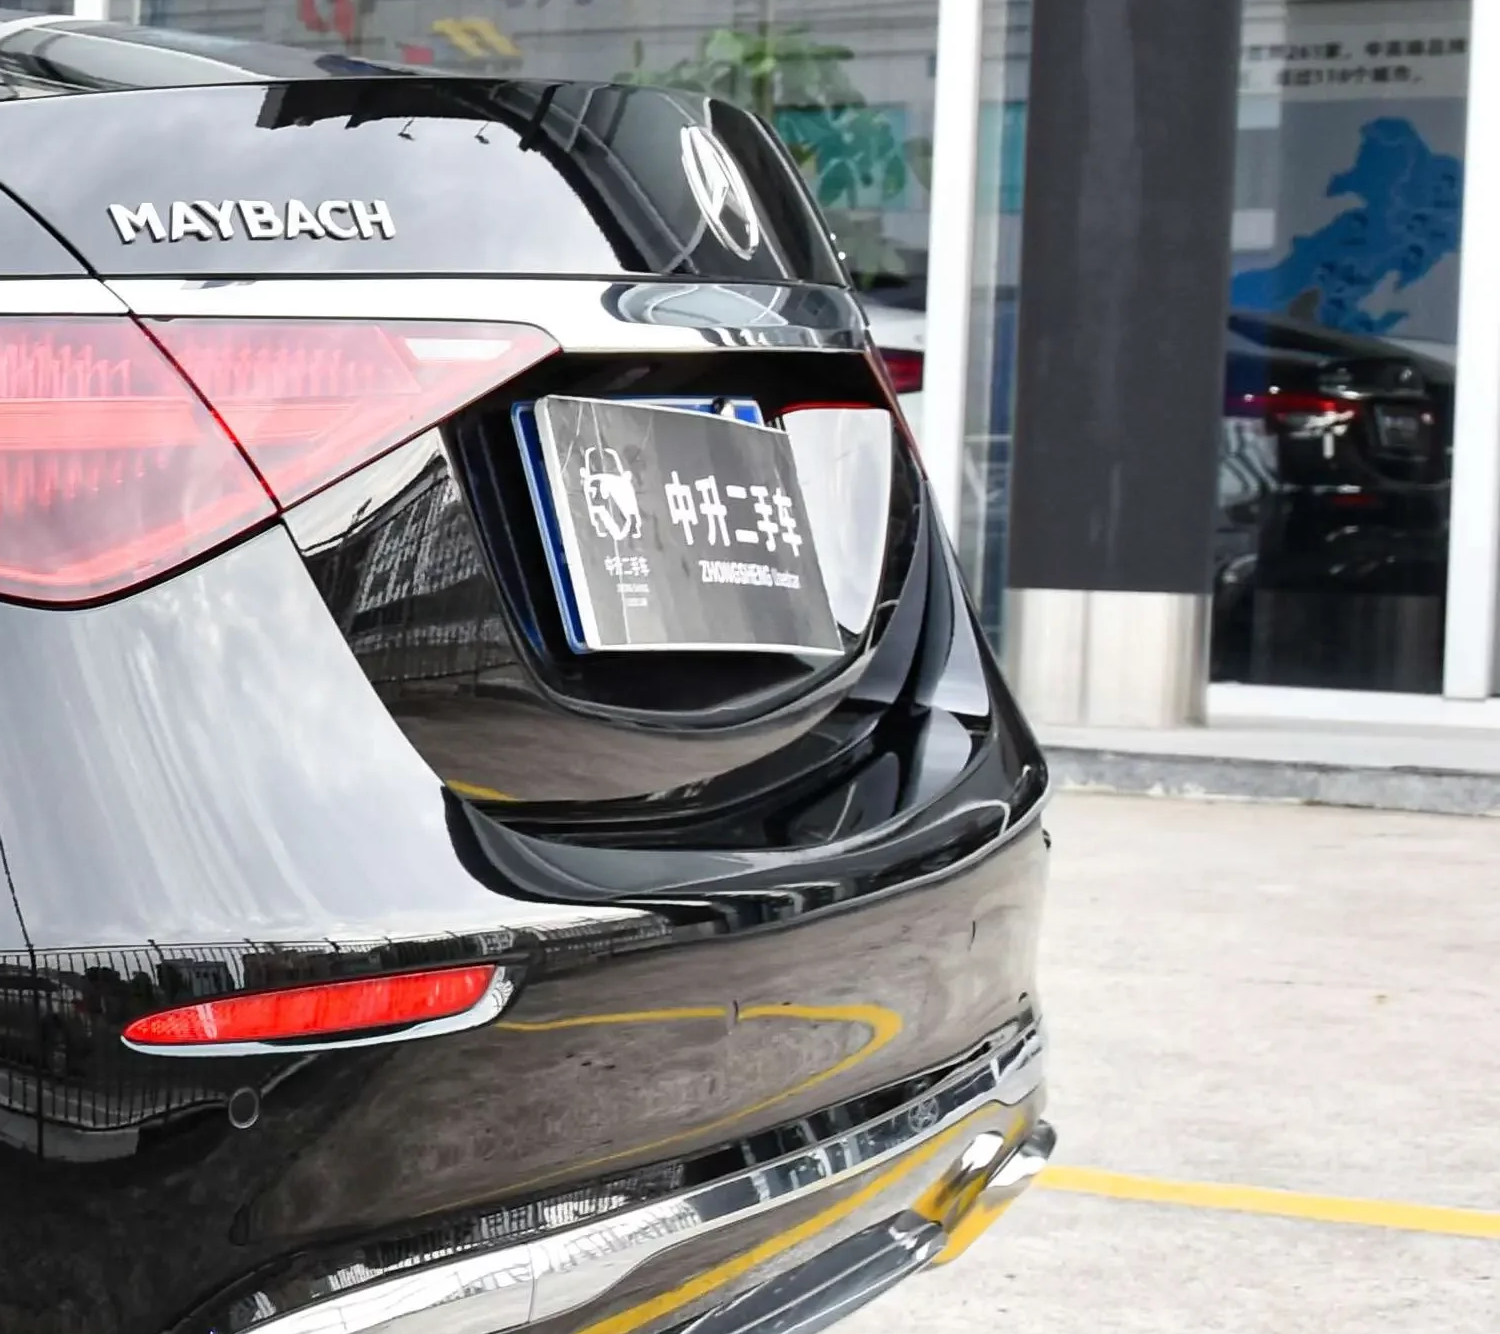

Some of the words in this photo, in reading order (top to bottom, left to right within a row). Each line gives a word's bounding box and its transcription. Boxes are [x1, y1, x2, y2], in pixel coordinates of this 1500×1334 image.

[107, 199, 397, 244] MAYBACH
[664, 470, 804, 558] 中升二手车
